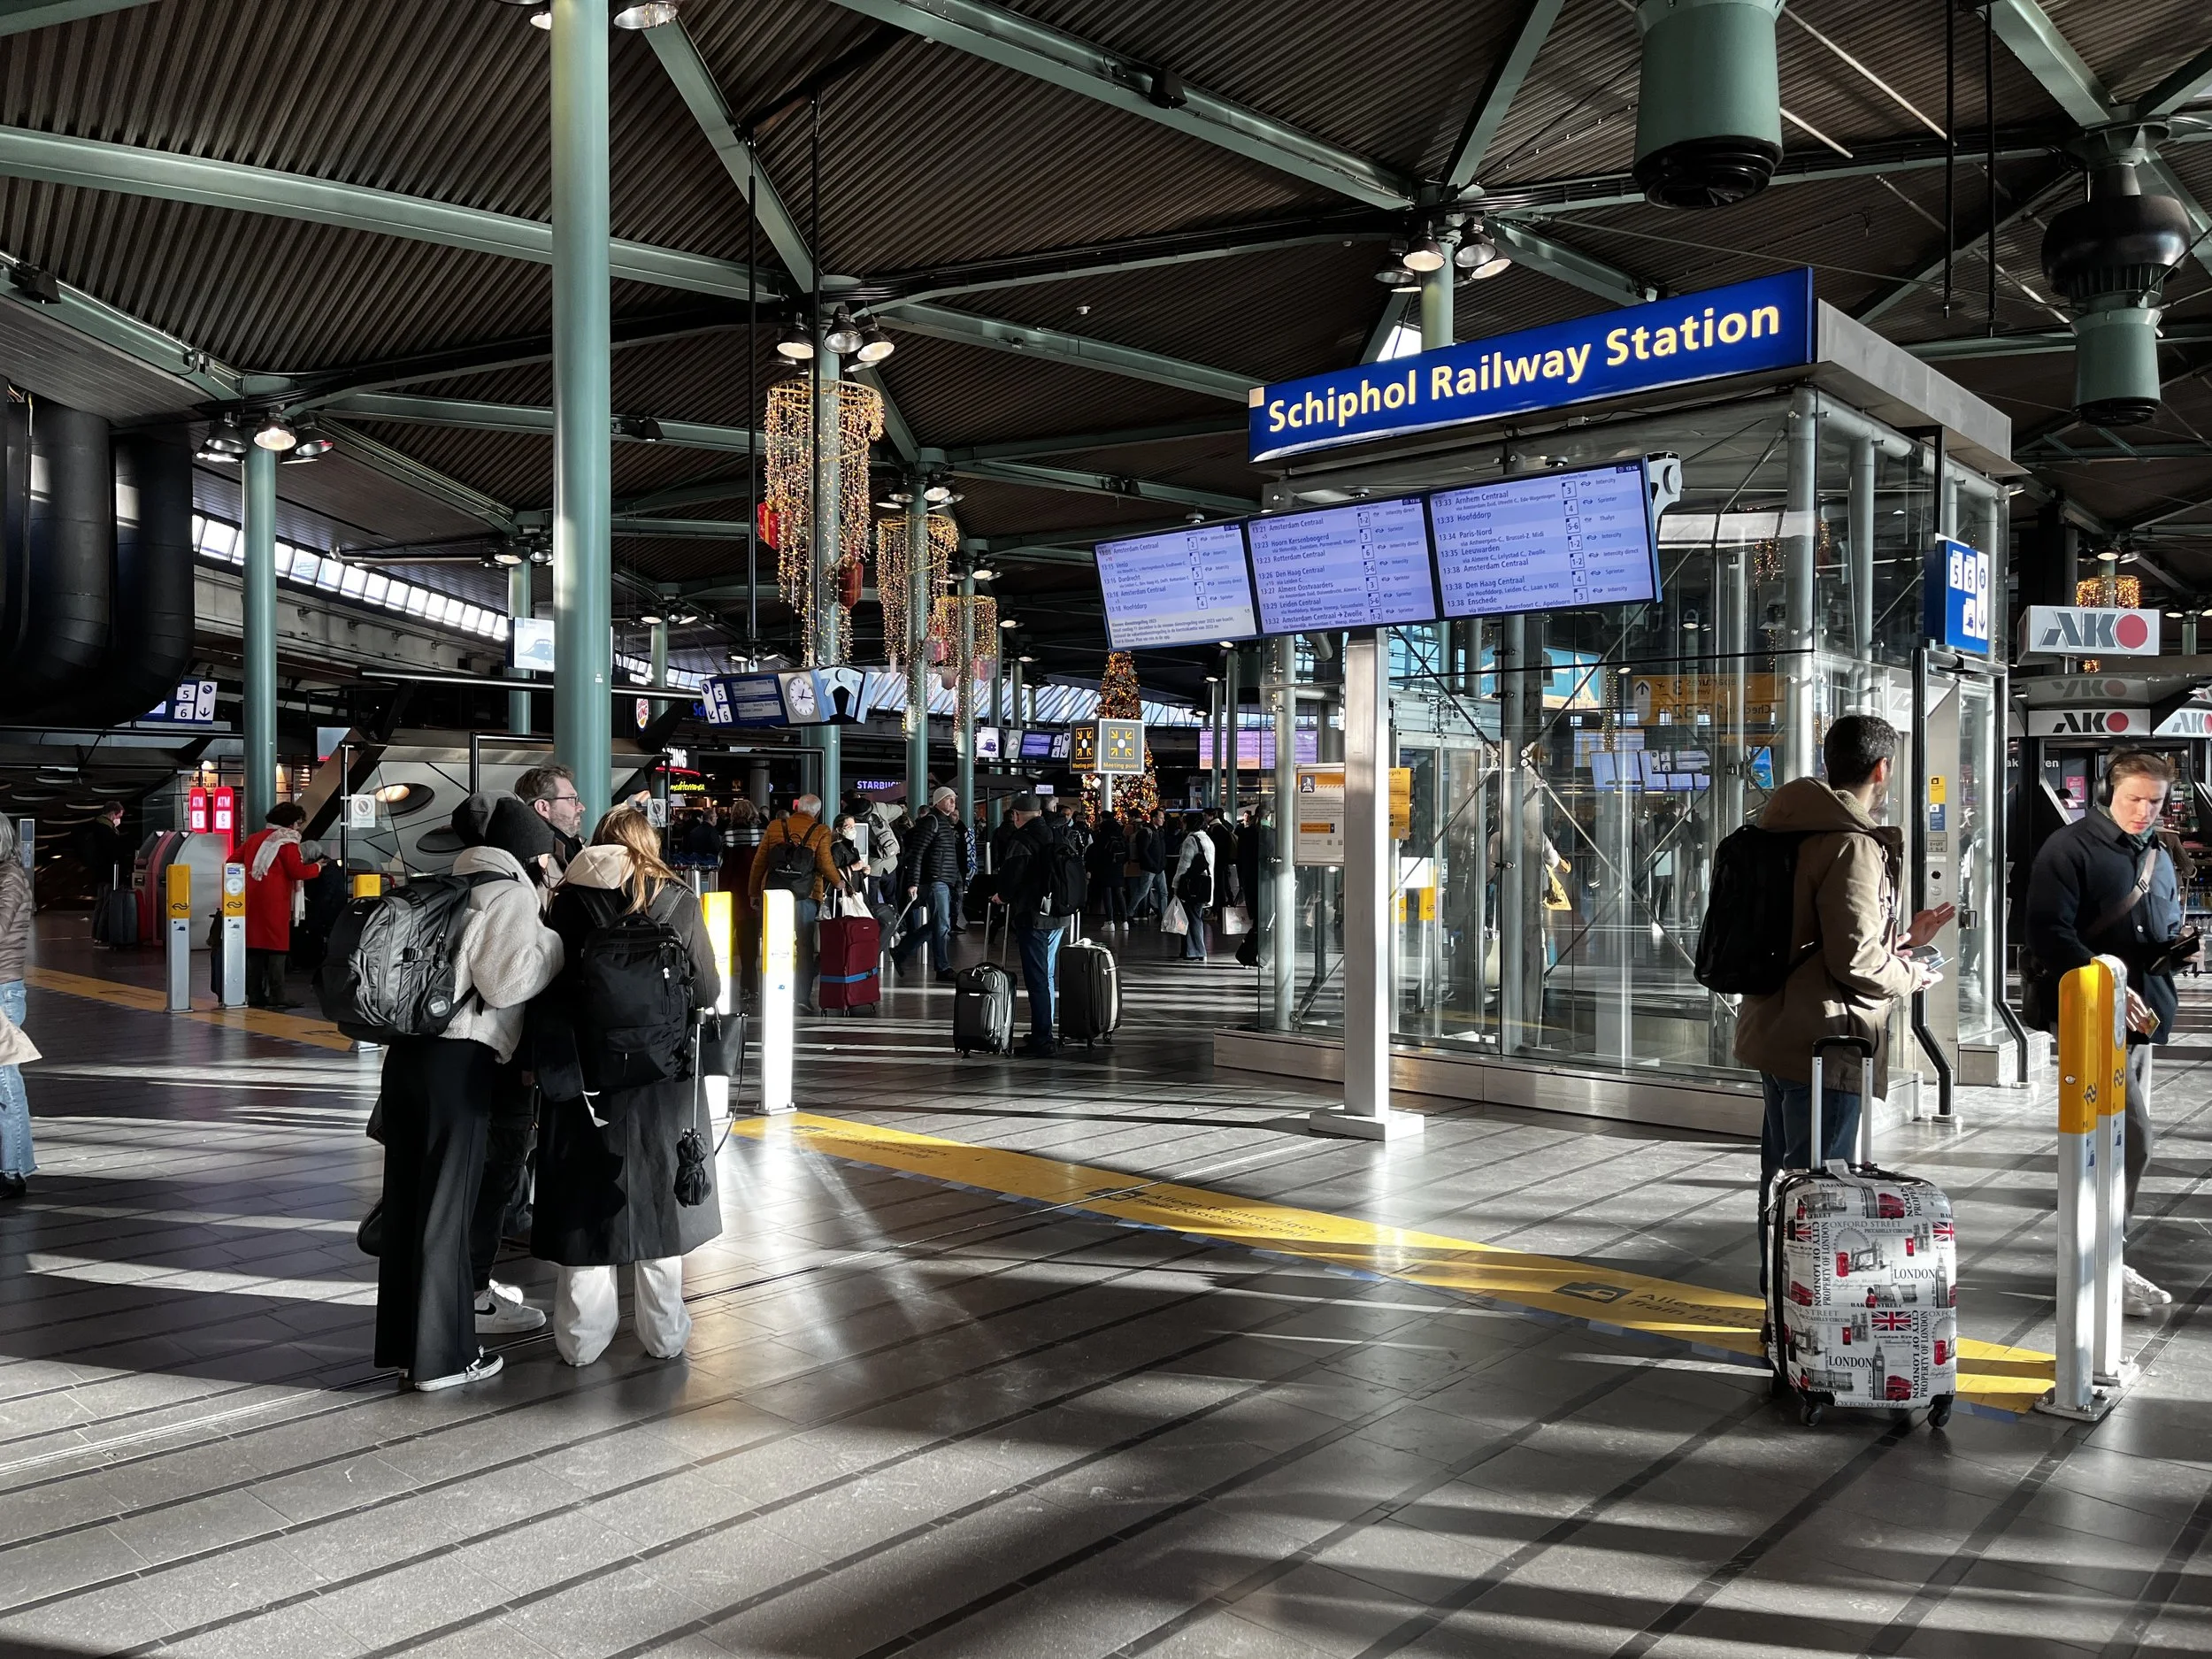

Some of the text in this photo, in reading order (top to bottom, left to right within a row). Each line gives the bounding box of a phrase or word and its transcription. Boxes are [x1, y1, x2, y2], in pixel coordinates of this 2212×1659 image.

[1268, 303, 1779, 433] Schiphol Railway Station
[1434, 498, 1452, 507] 13:33
[1455, 495, 1480, 504] Arnhem
[1481, 490, 1509, 501] Centraal
[1269, 522, 1300, 531] Amsterdam
[1301, 518, 1325, 527] Centraal
[1437, 515, 1454, 525] 13:33
[1457, 511, 1492, 522] Hoofddorp
[1439, 533, 1456, 541] 13:34
[1459, 528, 1493, 539] Paris-Nord
[1568, 522, 1578, 531] 5-6
[1140, 541, 1158, 550] Centraal
[1271, 539, 1288, 548] Hoorn
[1288, 533, 1330, 545] Kersenboogerd
[1441, 532, 1622, 558] 13:35 Leeuwarden 1-2 Intercity
[1273, 552, 1302, 563] Rotterdam
[1302, 549, 1326, 559] Centraal
[1497, 551, 1519, 560] Lelystad
[1302, 565, 1325, 575] Centraal
[1463, 563, 1500, 572] Amsterdam
[1501, 558, 1529, 568] Centraal
[1118, 574, 1141, 583] Dordrecht
[1954, 565, 1959, 584] 5
[1967, 569, 1972, 589] 6
[1147, 585, 1166, 594] Centraal
[1297, 581, 1334, 591] Oostvaarders
[1445, 582, 1463, 591] 13:38
[1465, 580, 1479, 589] Den
[1479, 580, 1497, 589] Haag
[1497, 575, 1525, 586] Centraal
[1280, 600, 1299, 609] Leiden
[1299, 598, 1321, 607] Centraal
[1448, 599, 1465, 608] 13:38
[1468, 596, 1498, 605] Enschede
[1505, 599, 1571, 611] Amersfoort Apeldoorn
[1282, 614, 1313, 624] Amsterdam
[1313, 611, 1337, 621] Centraal
[1344, 610, 1363, 618] Zwolle
[2039, 611, 2148, 649] AKO
[182, 690, 189, 699] 5
[718, 690, 724, 700] 5
[180, 709, 187, 718] 6
[723, 710, 729, 721] 6
[2052, 711, 2129, 733] AKO
[192, 796, 204, 807] ATM
[217, 796, 230, 807] ATM
[1151, 1194, 1330, 1233] Alleen treinreizigers
[1813, 1248, 1821, 1261] OF
[1822, 1222, 1832, 1306] PROPERTY OF LONDON
[1893, 1268, 1935, 1279] LONDON
[1813, 1264, 1822, 1306] LONDON
[1627, 1299, 1686, 1316] Train
[1637, 1294, 1721, 1314] Alleen
[1912, 1336, 1919, 1349] OF
[1920, 1345, 1928, 1355] OF
[1829, 1356, 1872, 1368] LONDON
